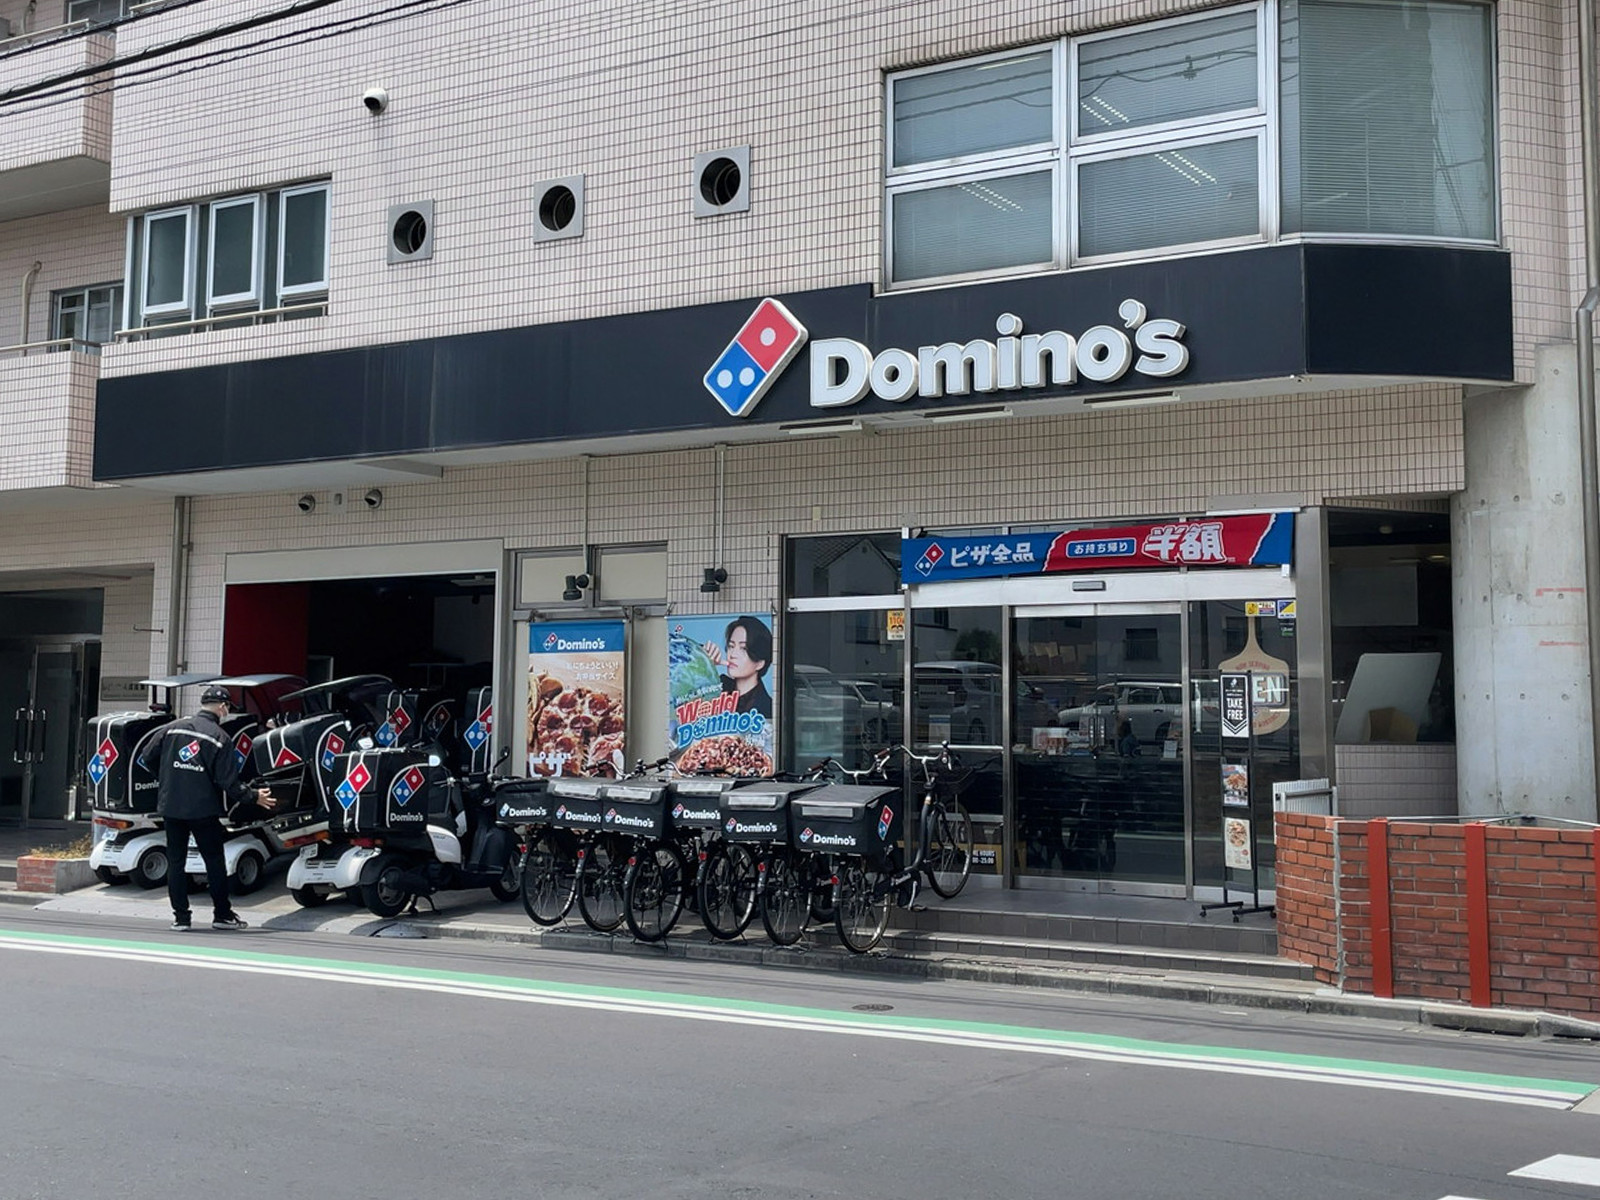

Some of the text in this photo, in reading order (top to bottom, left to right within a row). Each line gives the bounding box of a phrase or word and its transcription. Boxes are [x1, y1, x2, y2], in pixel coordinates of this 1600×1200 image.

[809, 298, 1190, 407] Domino's
[950, 523, 1225, 567] ピザ全品 お持ち帰り 半額
[557, 637, 606, 651] Domino's
[1252, 676, 1281, 703] EN
[676, 690, 740, 725] World
[1226, 697, 1244, 709] TAKE
[1227, 709, 1244, 720] FREE
[677, 708, 766, 749] Domino's
[529, 751, 571, 778] ピザ
[134, 779, 159, 791] Domi
[389, 811, 424, 822] Domino's
[508, 806, 548, 817] Domino's
[682, 808, 721, 821] Domino's
[614, 814, 655, 828] Domino's
[735, 821, 778, 833] Domino's
[812, 832, 857, 847] Domino's
